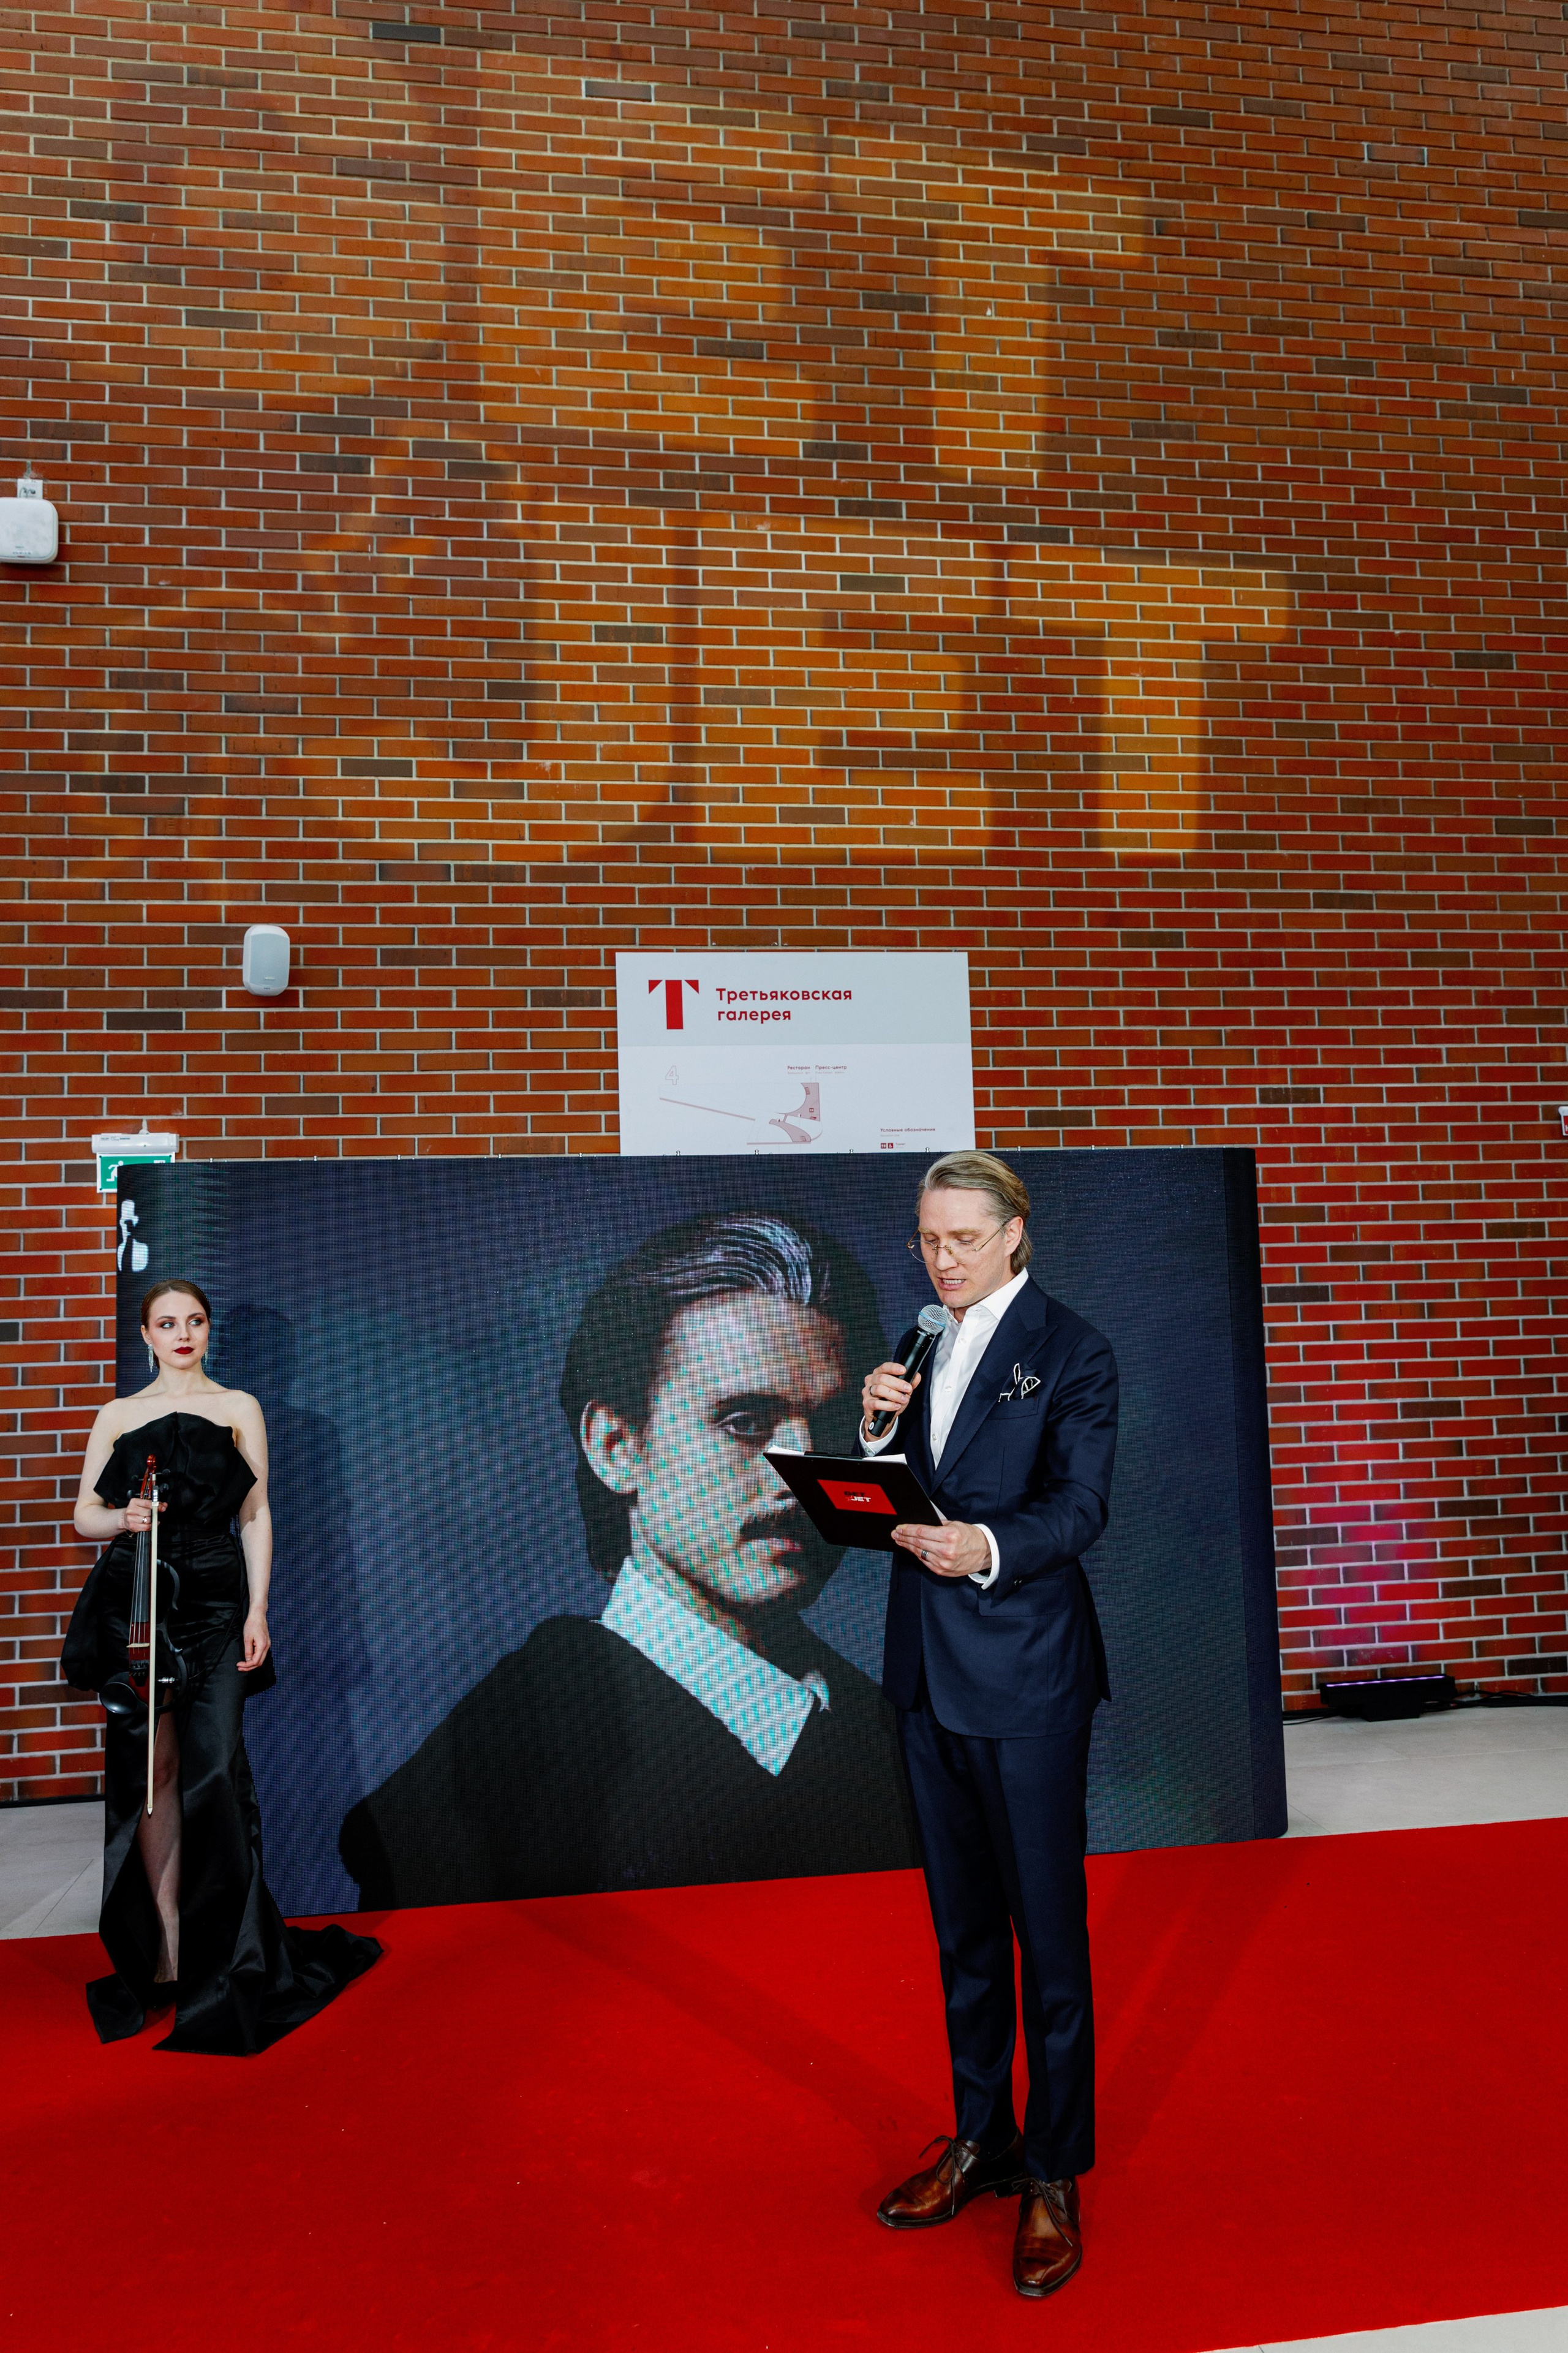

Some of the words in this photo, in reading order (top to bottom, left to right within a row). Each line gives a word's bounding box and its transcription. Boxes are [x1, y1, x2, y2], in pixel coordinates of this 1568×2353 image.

[715, 988, 853, 1004] Третьяковская
[717, 1011, 791, 1024] галерея
[665, 1065, 679, 1086] 4
